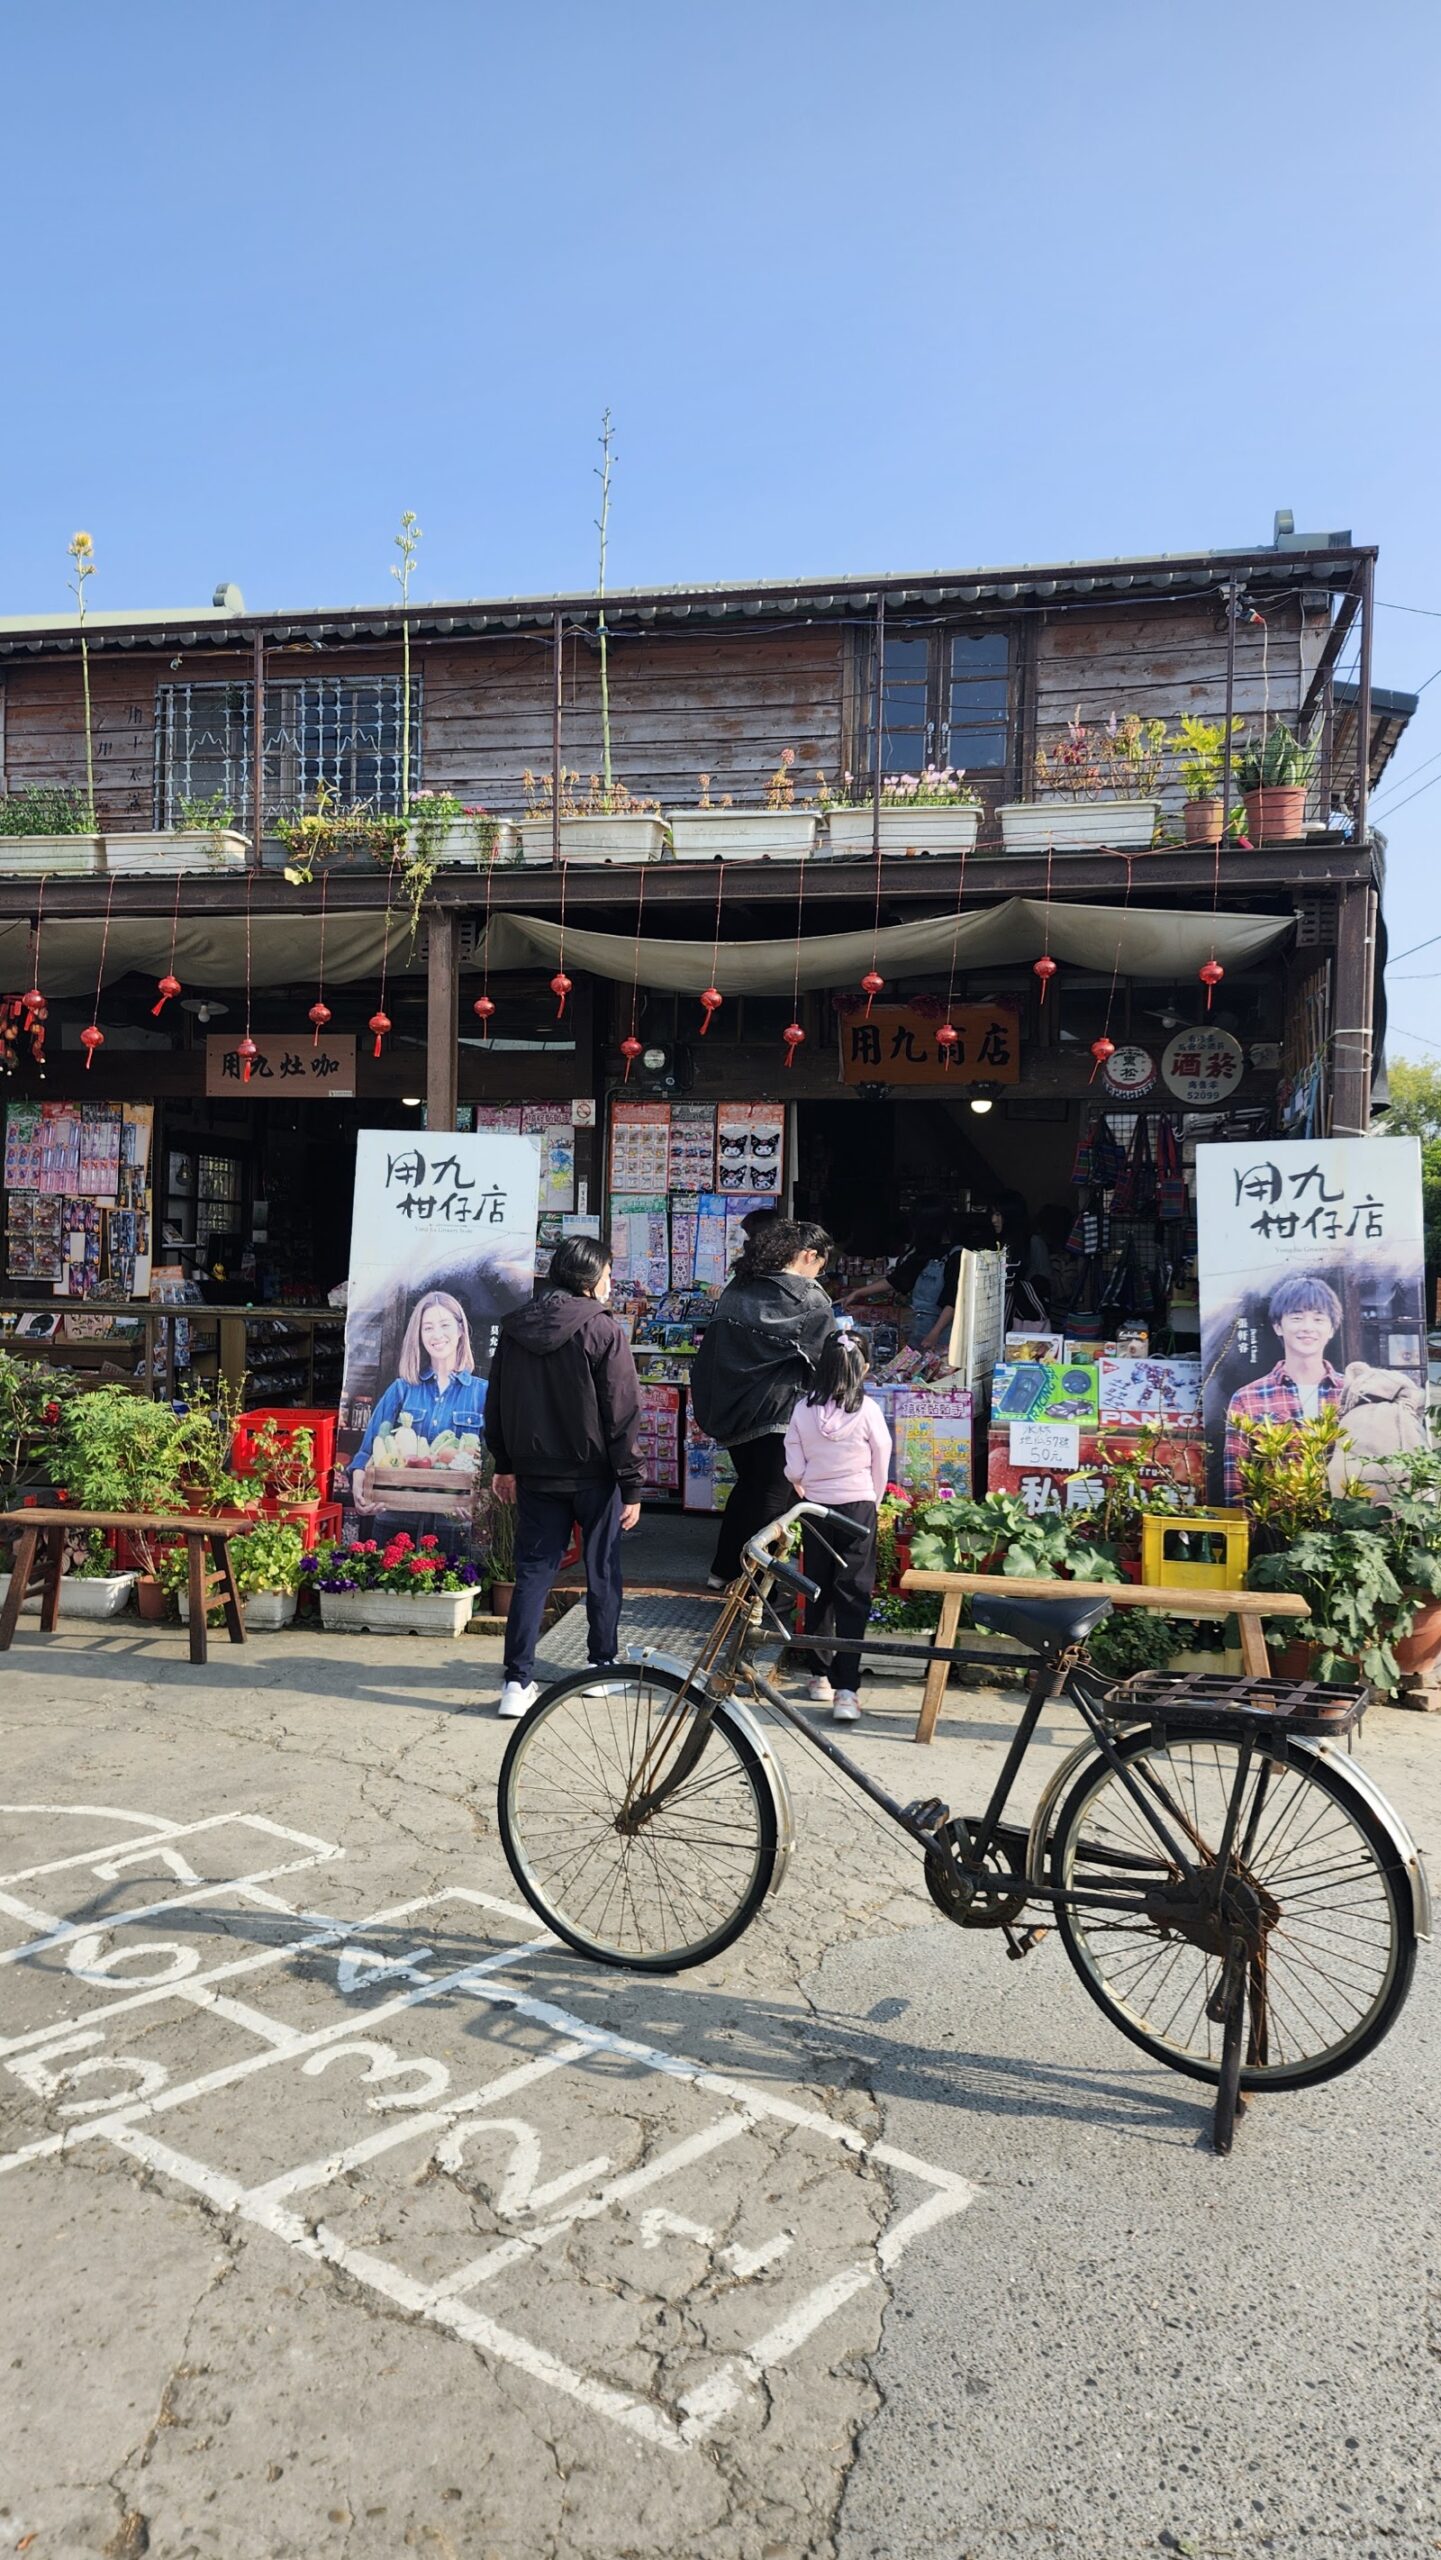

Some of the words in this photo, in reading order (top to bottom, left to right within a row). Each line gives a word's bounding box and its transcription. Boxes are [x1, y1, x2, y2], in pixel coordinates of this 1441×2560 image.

[221, 1051, 341, 1080] 用九灶咖
[850, 1023, 1011, 1066] 用九商店
[1120, 1055, 1139, 1078] 黑松
[1186, 1091, 1220, 1100] 52099
[385, 1149, 476, 1189] 用九
[1233, 1161, 1345, 1207] 用九
[396, 1183, 508, 1224] 柑仔店
[1251, 1193, 1385, 1239] 柑仔店
[1101, 1411, 1204, 1428] PANLO
[1030, 1447, 1063, 1463] 50元
[92, 1846, 204, 1886] 7
[66, 1935, 201, 1989] 6
[338, 1945, 434, 1993] 4
[3, 2031, 169, 2117] 5
[301, 2040, 450, 2111] 3
[436, 2117, 611, 2219] 2
[640, 2207, 797, 2277] 1
